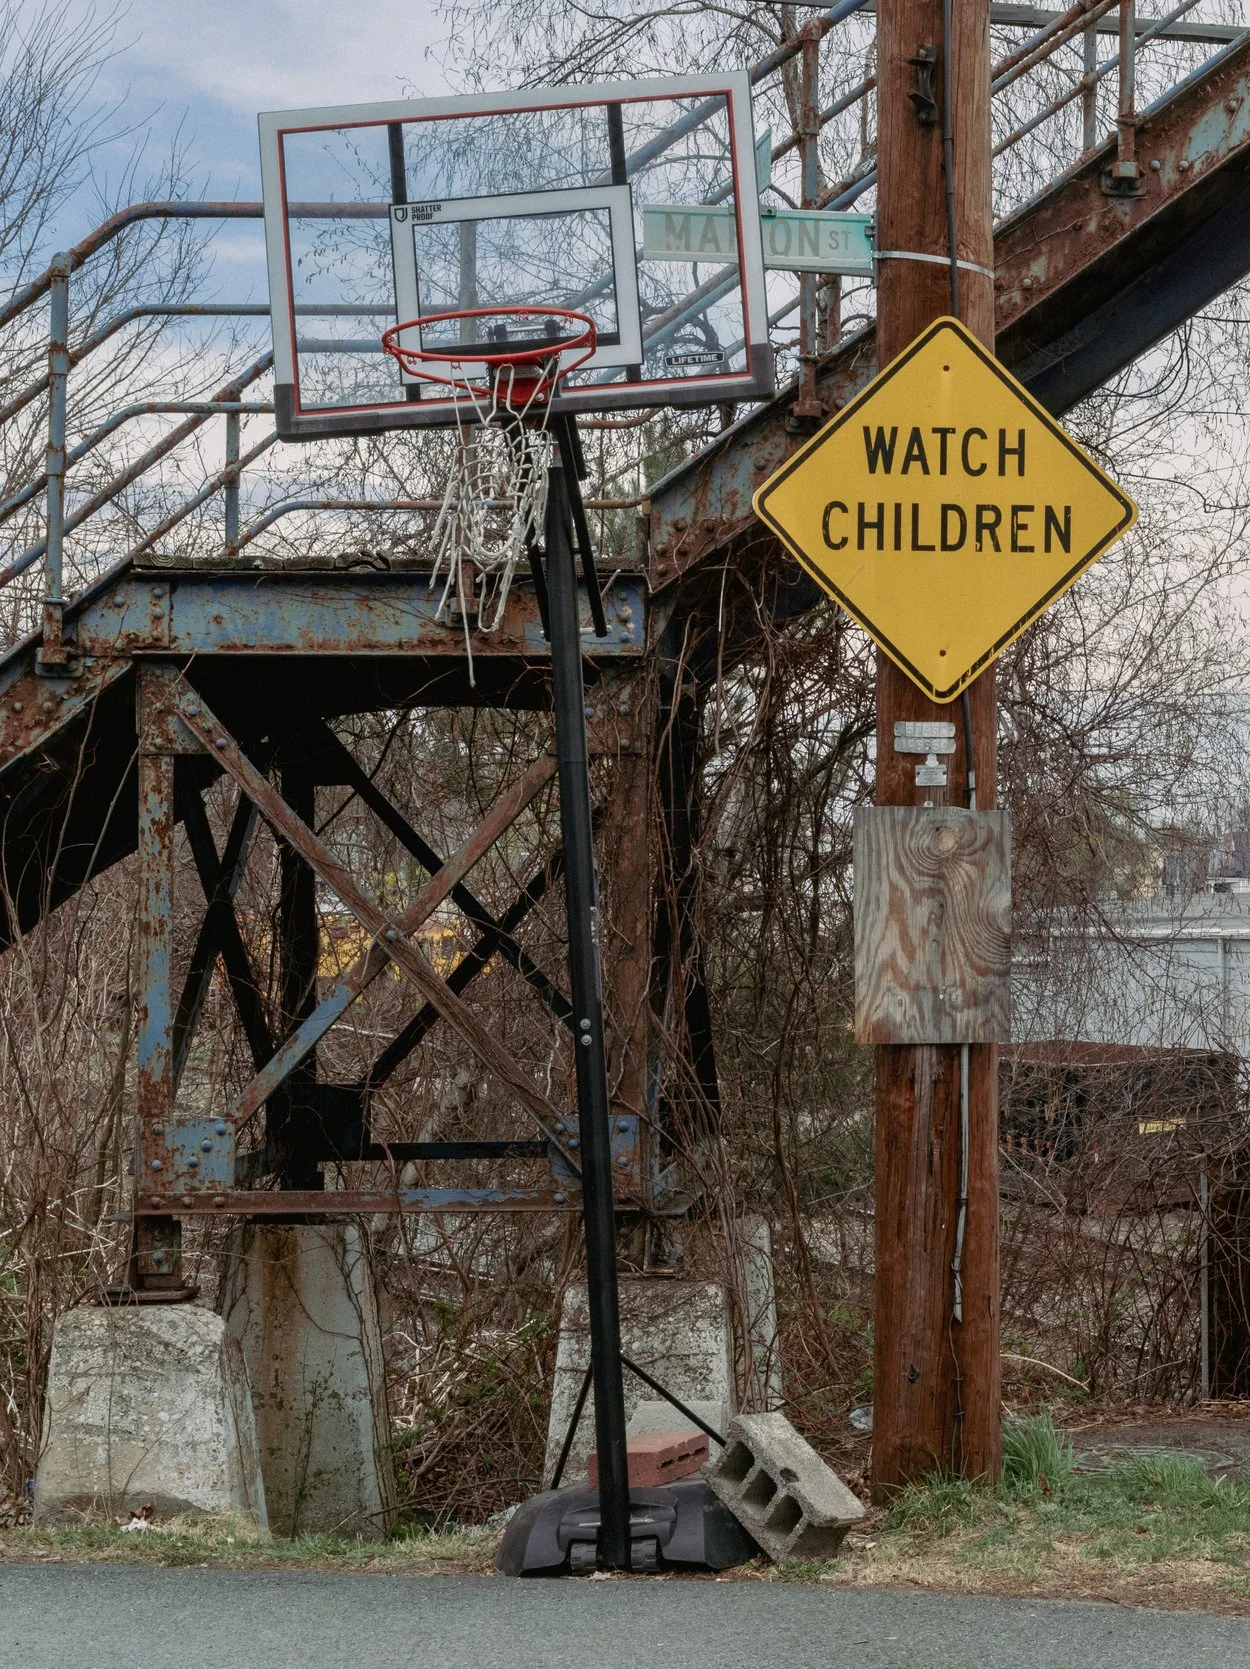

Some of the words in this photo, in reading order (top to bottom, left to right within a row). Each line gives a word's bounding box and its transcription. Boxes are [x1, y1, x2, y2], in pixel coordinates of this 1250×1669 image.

[411, 204, 442, 214] SHATTER
[411, 213, 434, 221] PROOF
[664, 213, 821, 259] MAON
[828, 230, 852, 251] ST
[671, 353, 719, 365] LIFETIME
[862, 425, 1026, 477] WATCH
[821, 500, 1073, 554] CHILDREN
